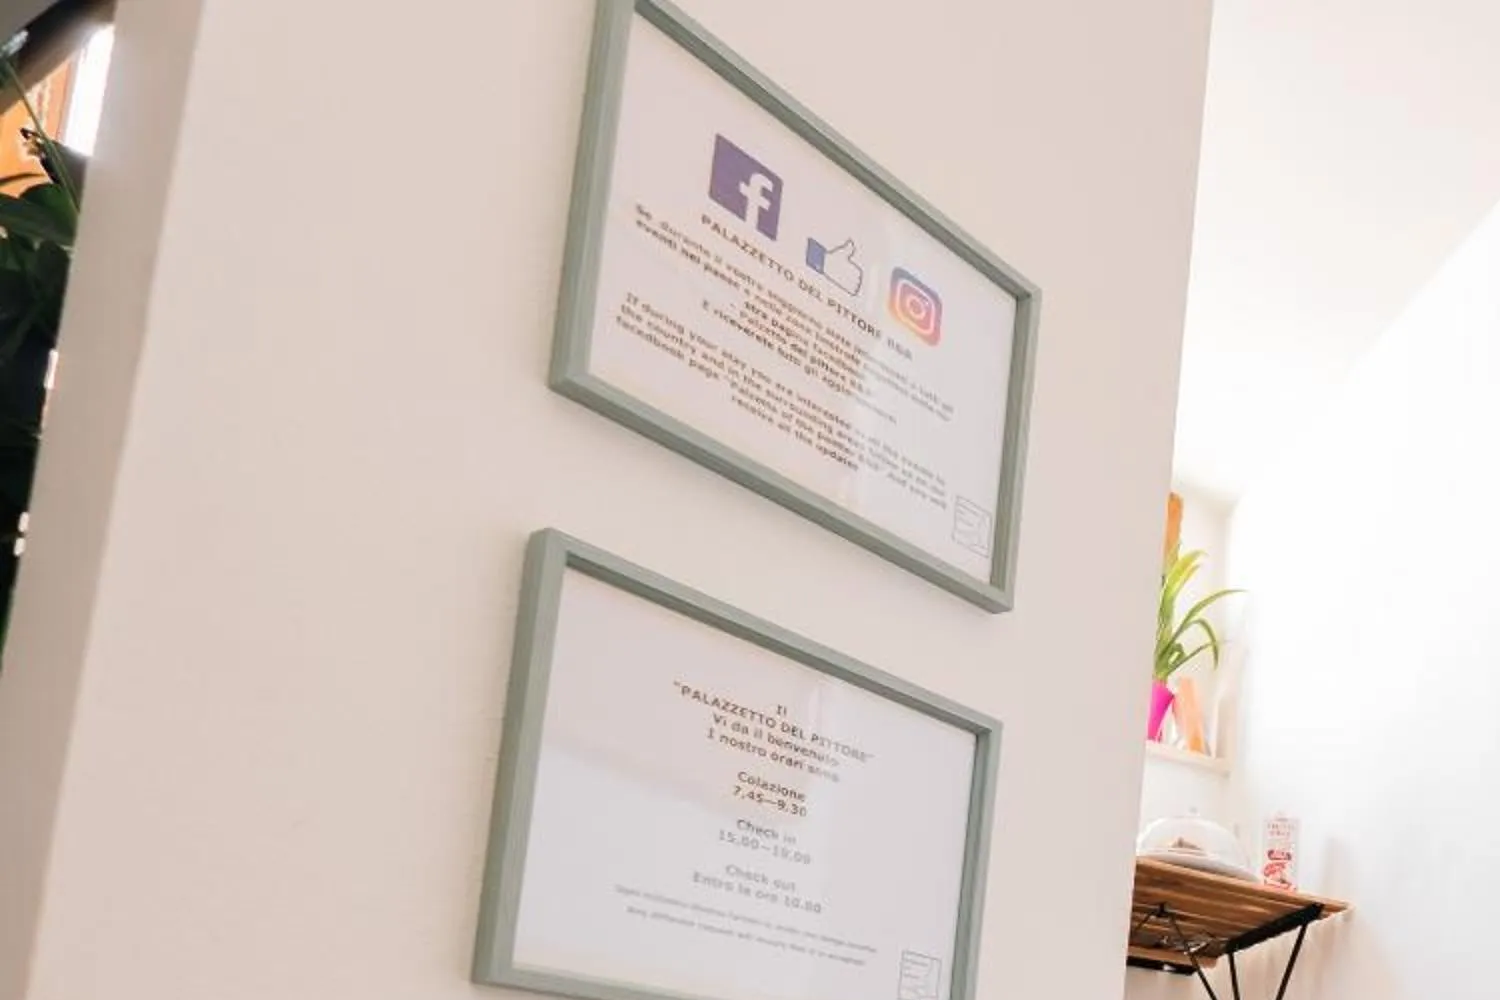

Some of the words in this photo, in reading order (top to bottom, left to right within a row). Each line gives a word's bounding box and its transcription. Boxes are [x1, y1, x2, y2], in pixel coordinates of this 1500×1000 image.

[701, 214, 794, 281] PALAZZETTO
[798, 279, 822, 301] DEL
[828, 298, 880, 337] PITTORE
[714, 714, 726, 726] Vi
[732, 723, 748, 734] da
[781, 722, 803, 739] DEL
[720, 735, 766, 756] nostro
[738, 772, 804, 802] Colazione
[737, 819, 778, 838] Check
[693, 871, 733, 891] Entro
[725, 865, 768, 884] Check
[773, 880, 795, 892] out
